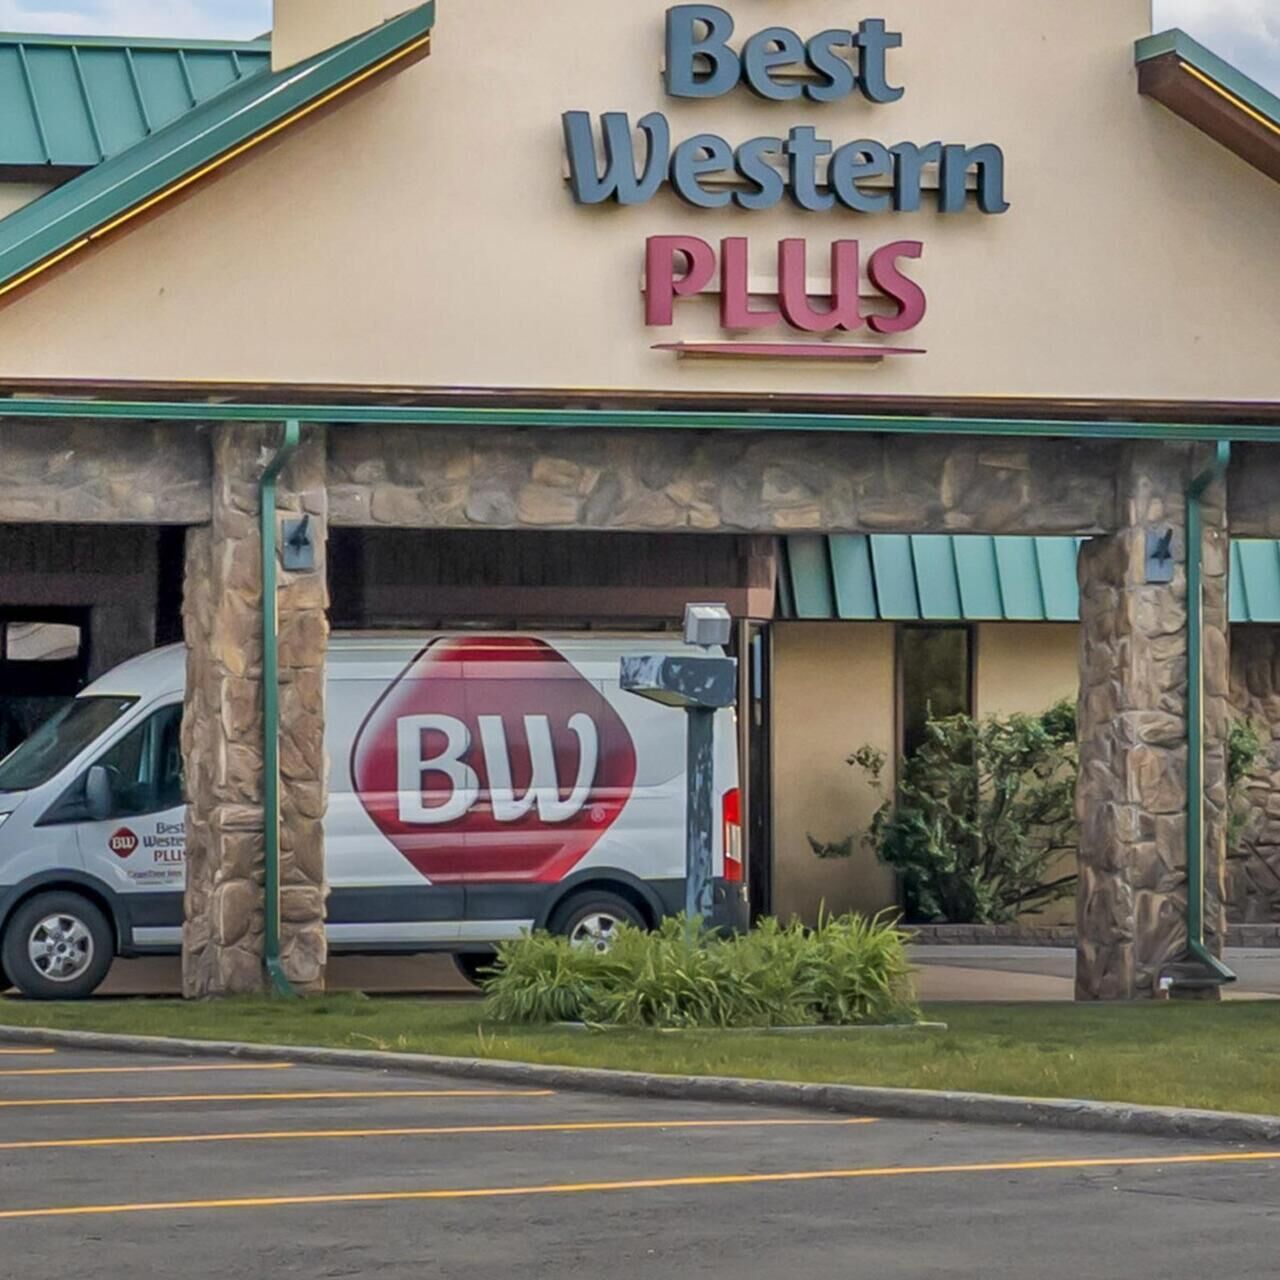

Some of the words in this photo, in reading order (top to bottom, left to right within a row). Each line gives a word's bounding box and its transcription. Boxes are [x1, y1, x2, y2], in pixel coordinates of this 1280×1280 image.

[663, 4, 905, 104] Best
[561, 110, 1011, 215] Western
[643, 234, 926, 334] PLUS
[396, 712, 598, 824] BW
[112, 836, 135, 849] BW
[143, 835, 185, 848] Weste
[154, 850, 186, 862] PLU
[156, 822, 185, 834] Best
